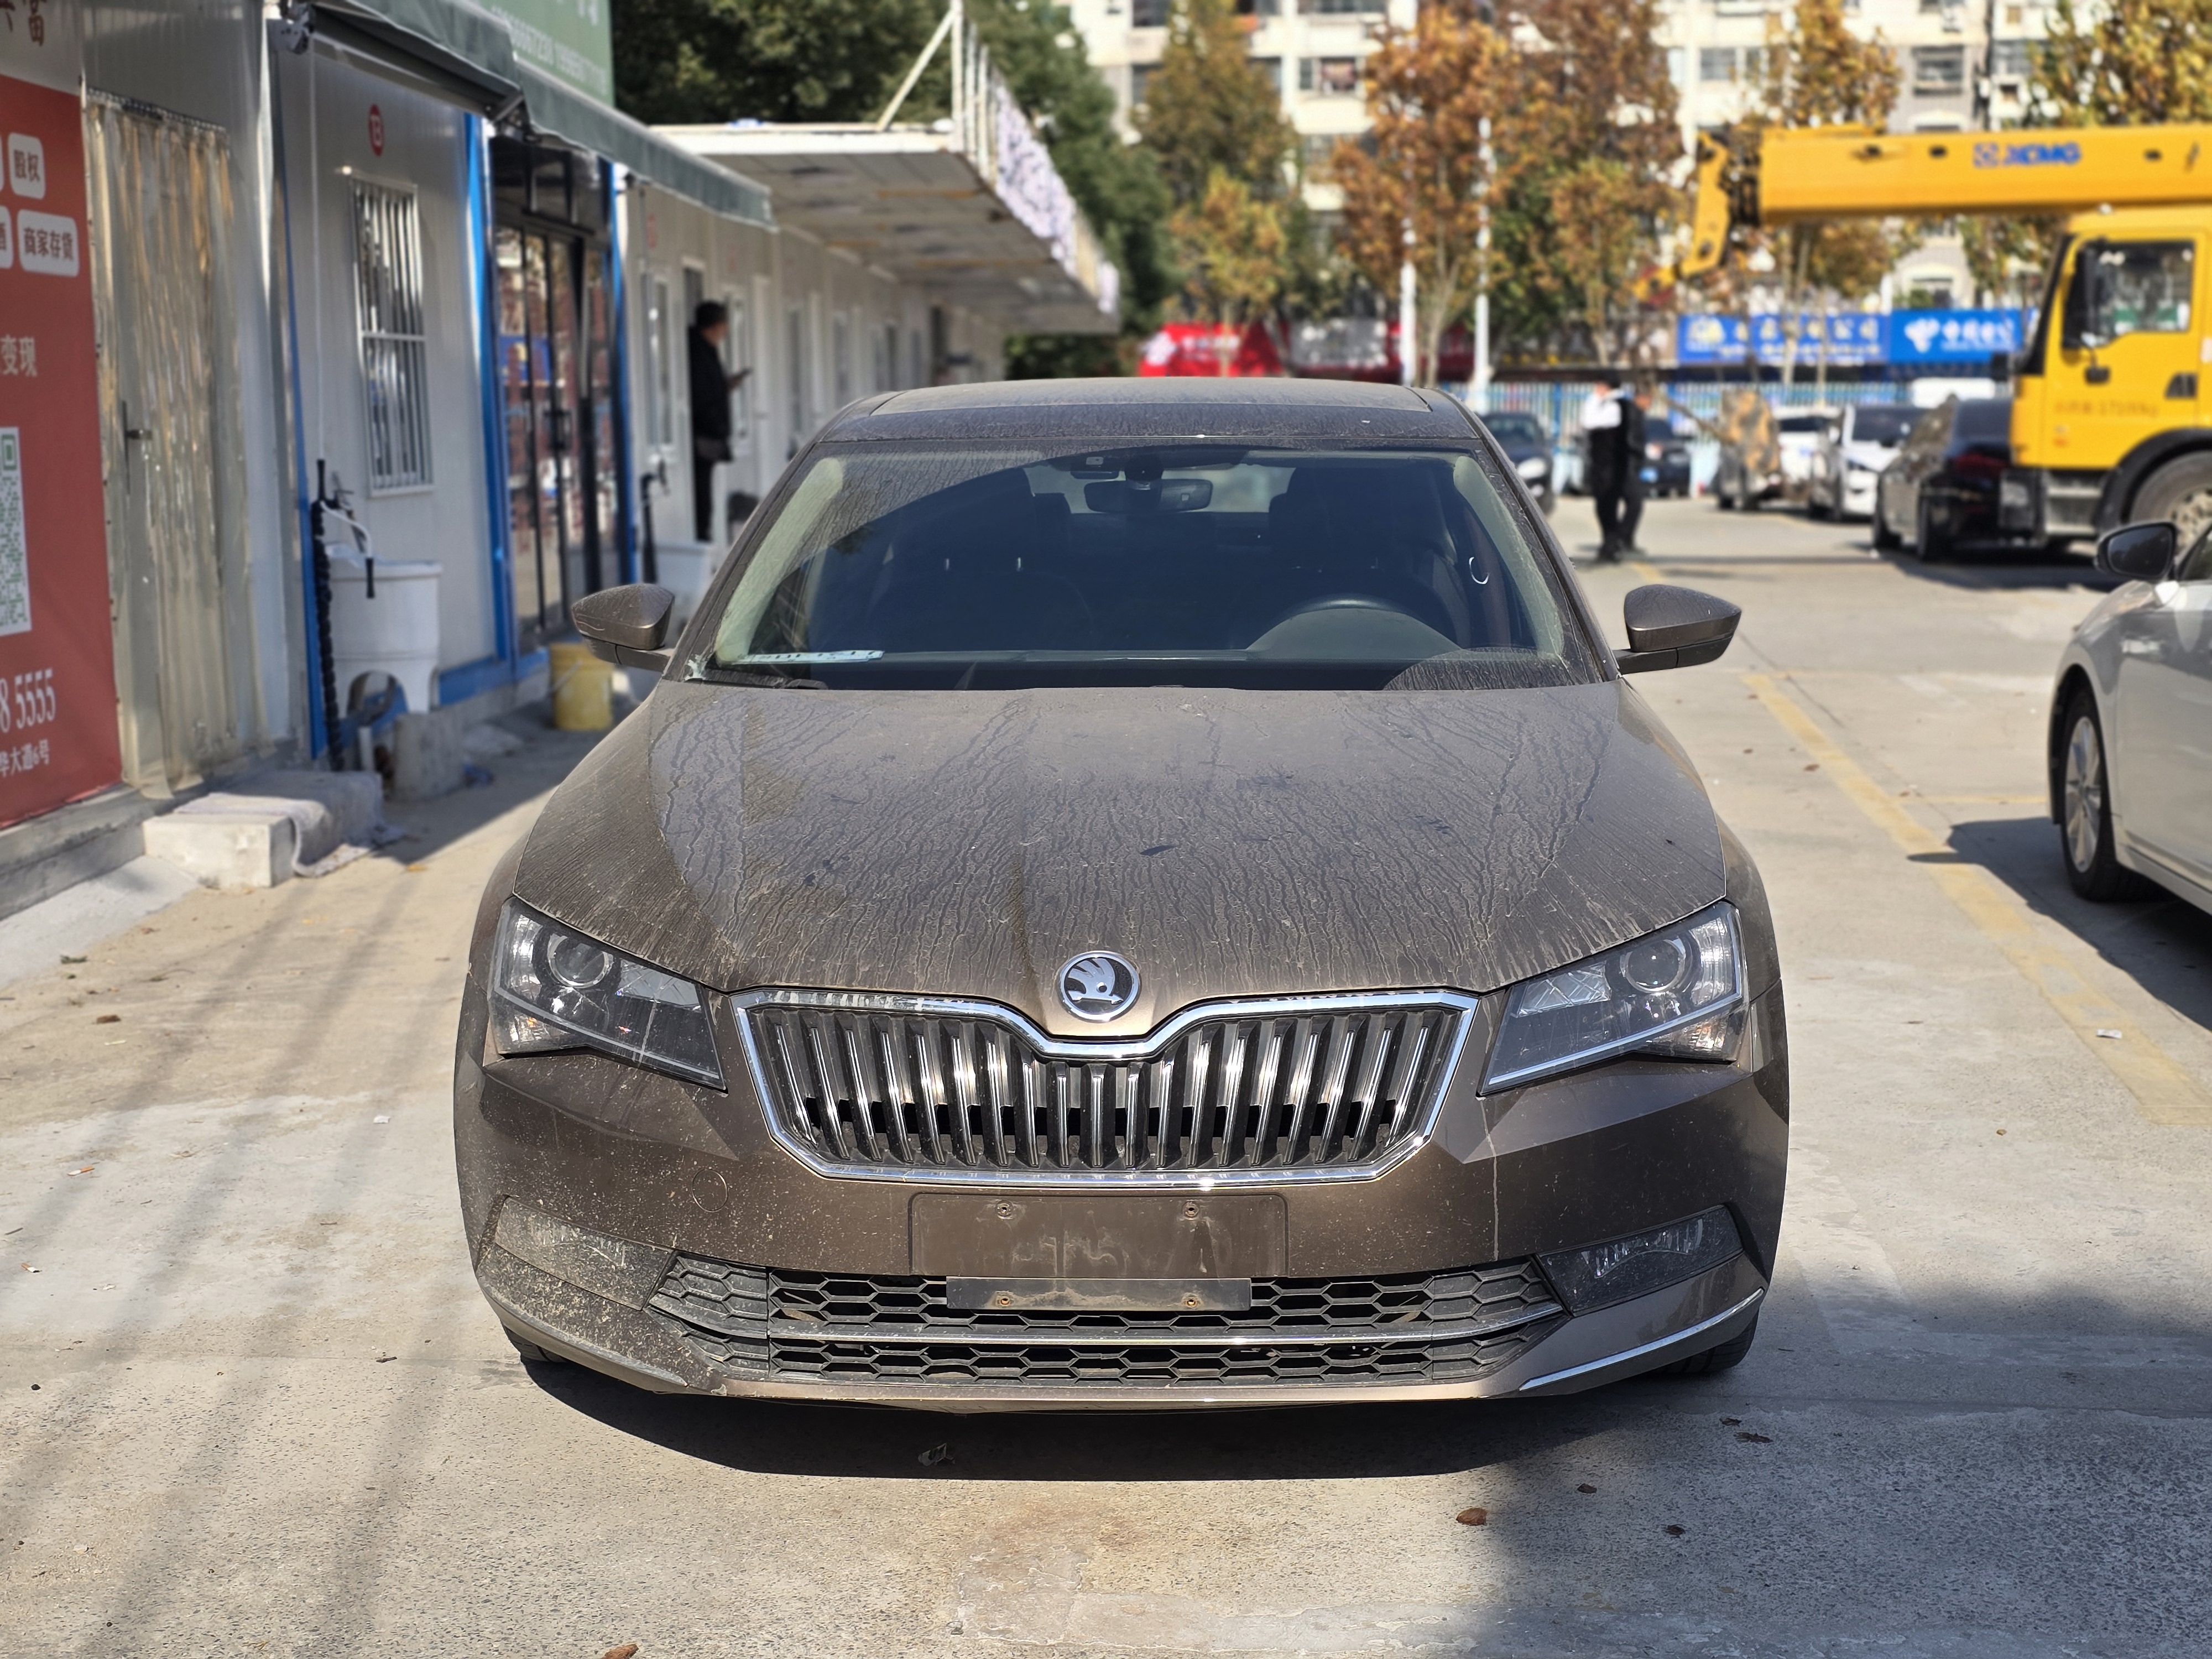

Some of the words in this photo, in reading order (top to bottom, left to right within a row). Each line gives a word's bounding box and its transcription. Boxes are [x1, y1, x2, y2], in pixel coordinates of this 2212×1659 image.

[23, 226, 73, 261] 商家存货
[14, 667, 55, 730] 5555
